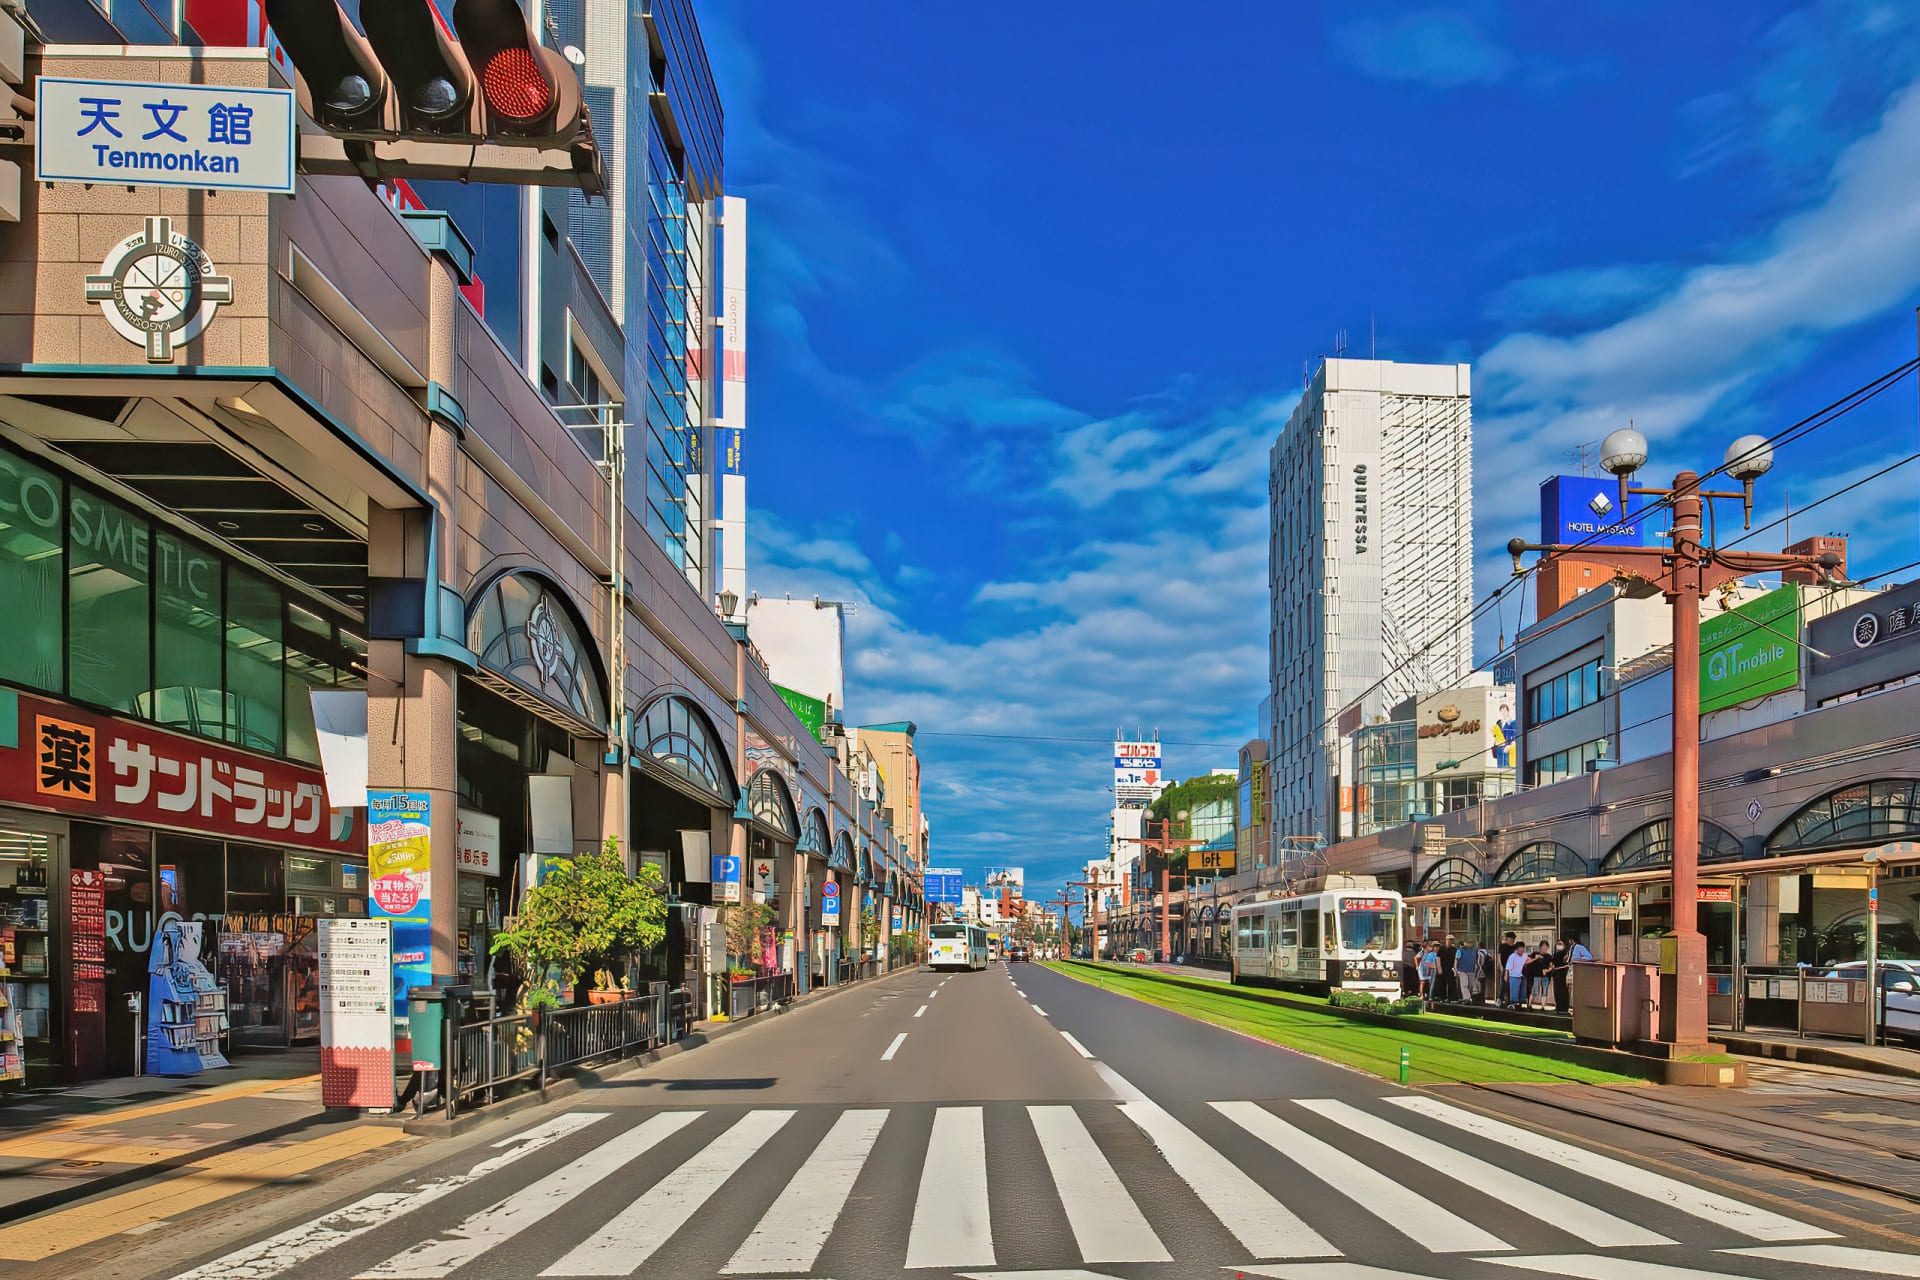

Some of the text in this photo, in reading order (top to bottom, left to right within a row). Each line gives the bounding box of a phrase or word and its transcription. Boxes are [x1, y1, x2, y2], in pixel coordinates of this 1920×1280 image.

[76, 97, 254, 145] 天文館
[92, 144, 240, 174] Tenmonkan
[1353, 463, 1368, 555] QUINTESSA
[1568, 522, 1594, 533] HOTEL
[40, 723, 92, 794] 薬
[107, 737, 324, 835] サンドラッグ
[720, 859, 735, 879] P
[826, 898, 837, 912] P
